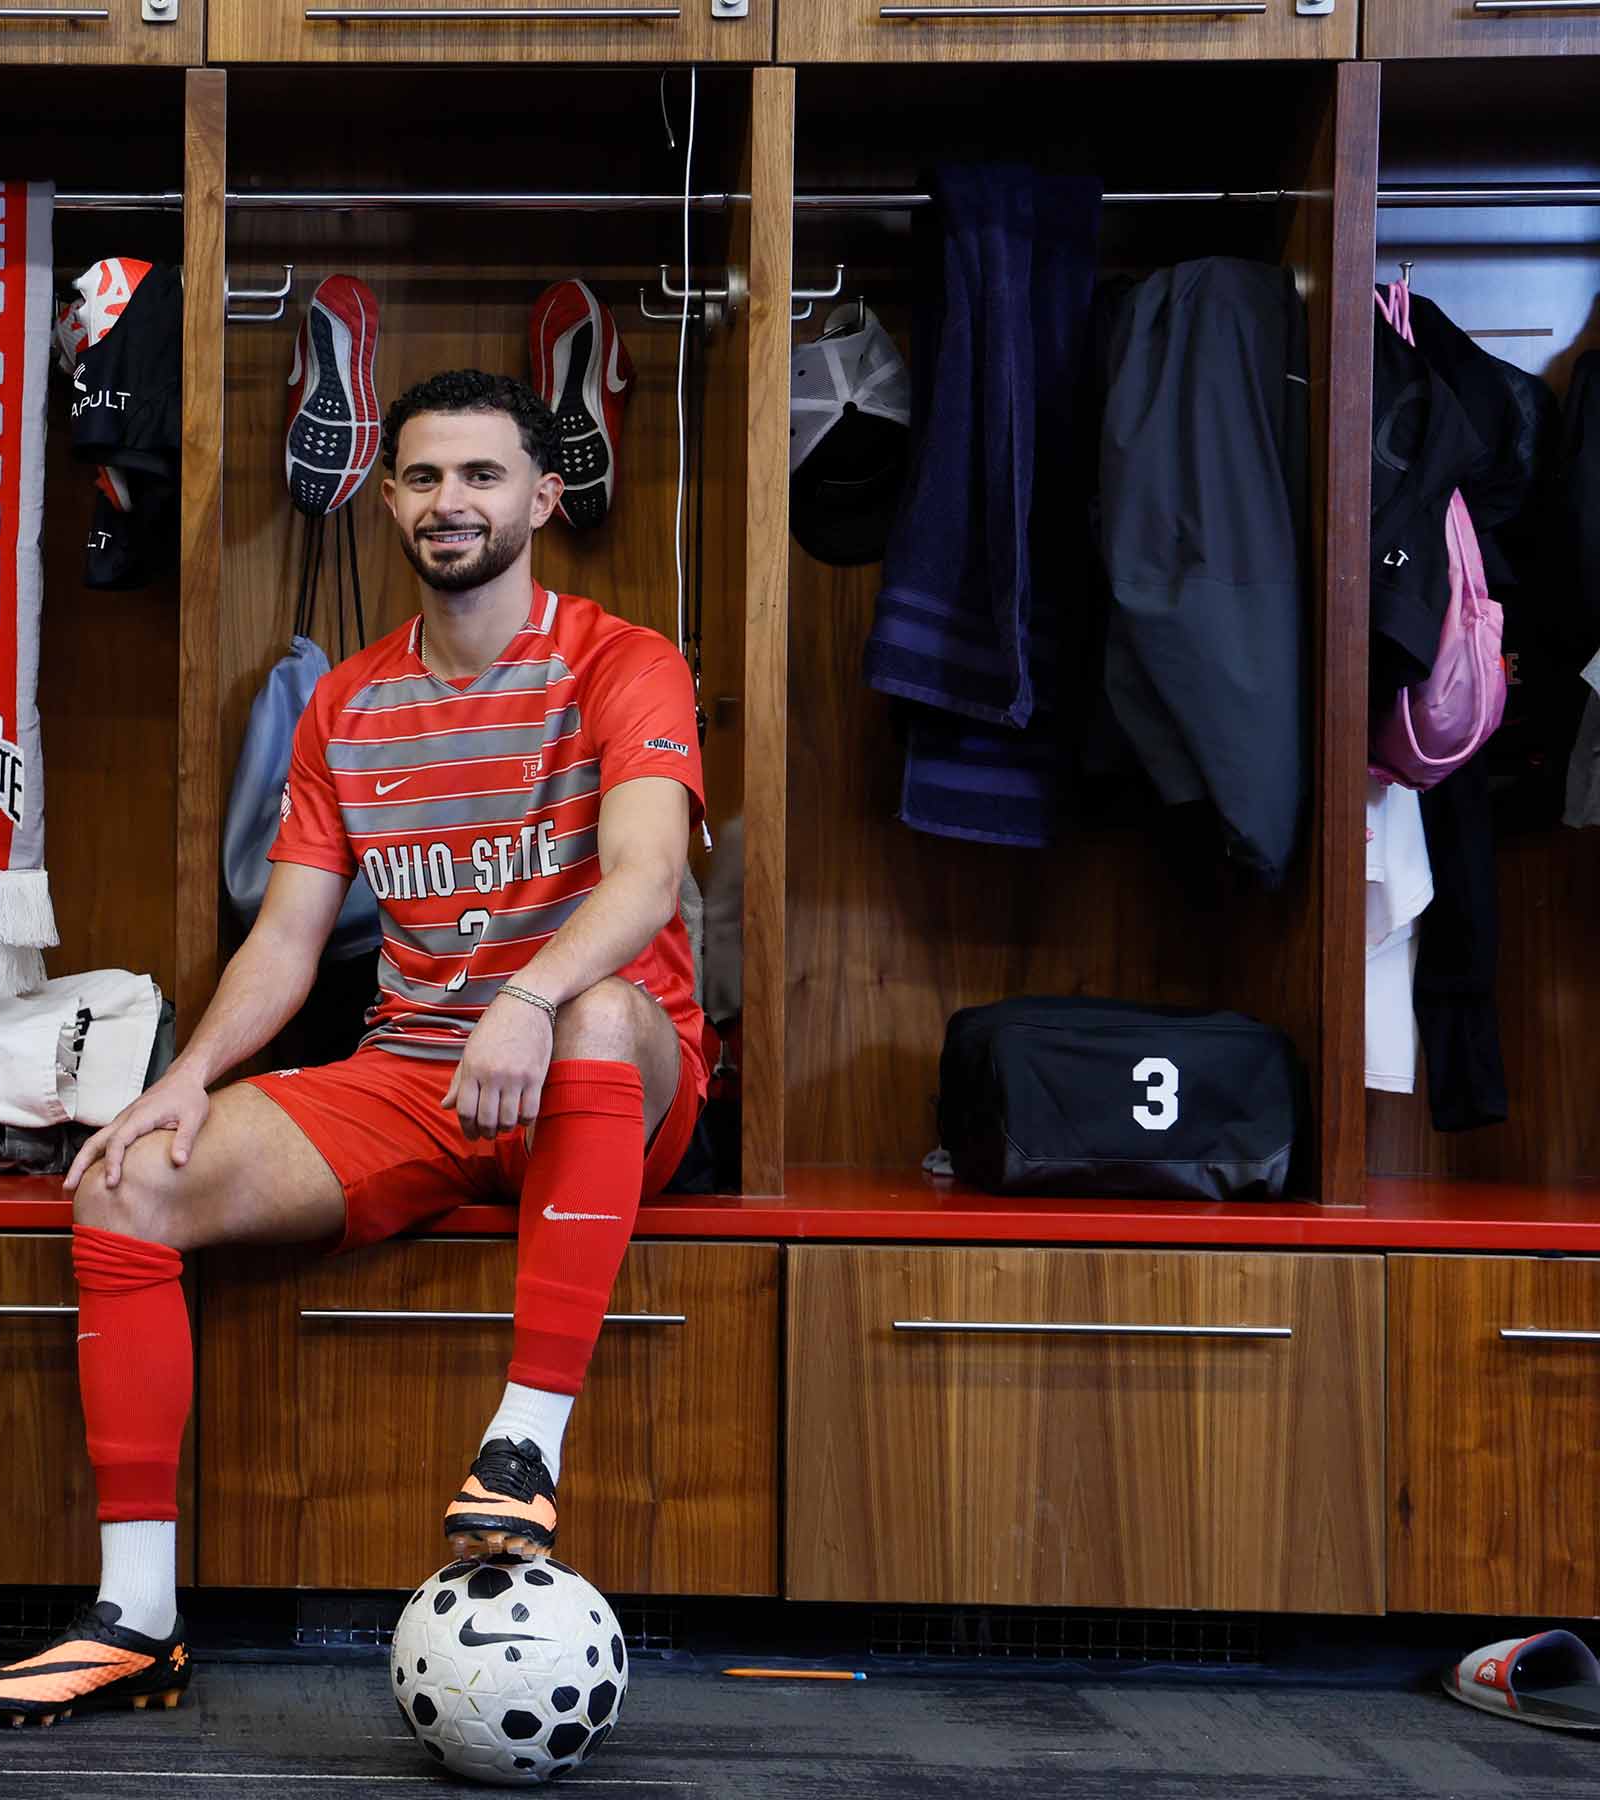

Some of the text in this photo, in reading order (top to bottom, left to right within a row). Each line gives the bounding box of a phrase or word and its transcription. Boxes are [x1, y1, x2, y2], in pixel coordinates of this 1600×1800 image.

[648, 738, 687, 753] EQUALITY
[363, 841, 456, 900] OHIO
[1132, 1057, 1179, 1130] 3
